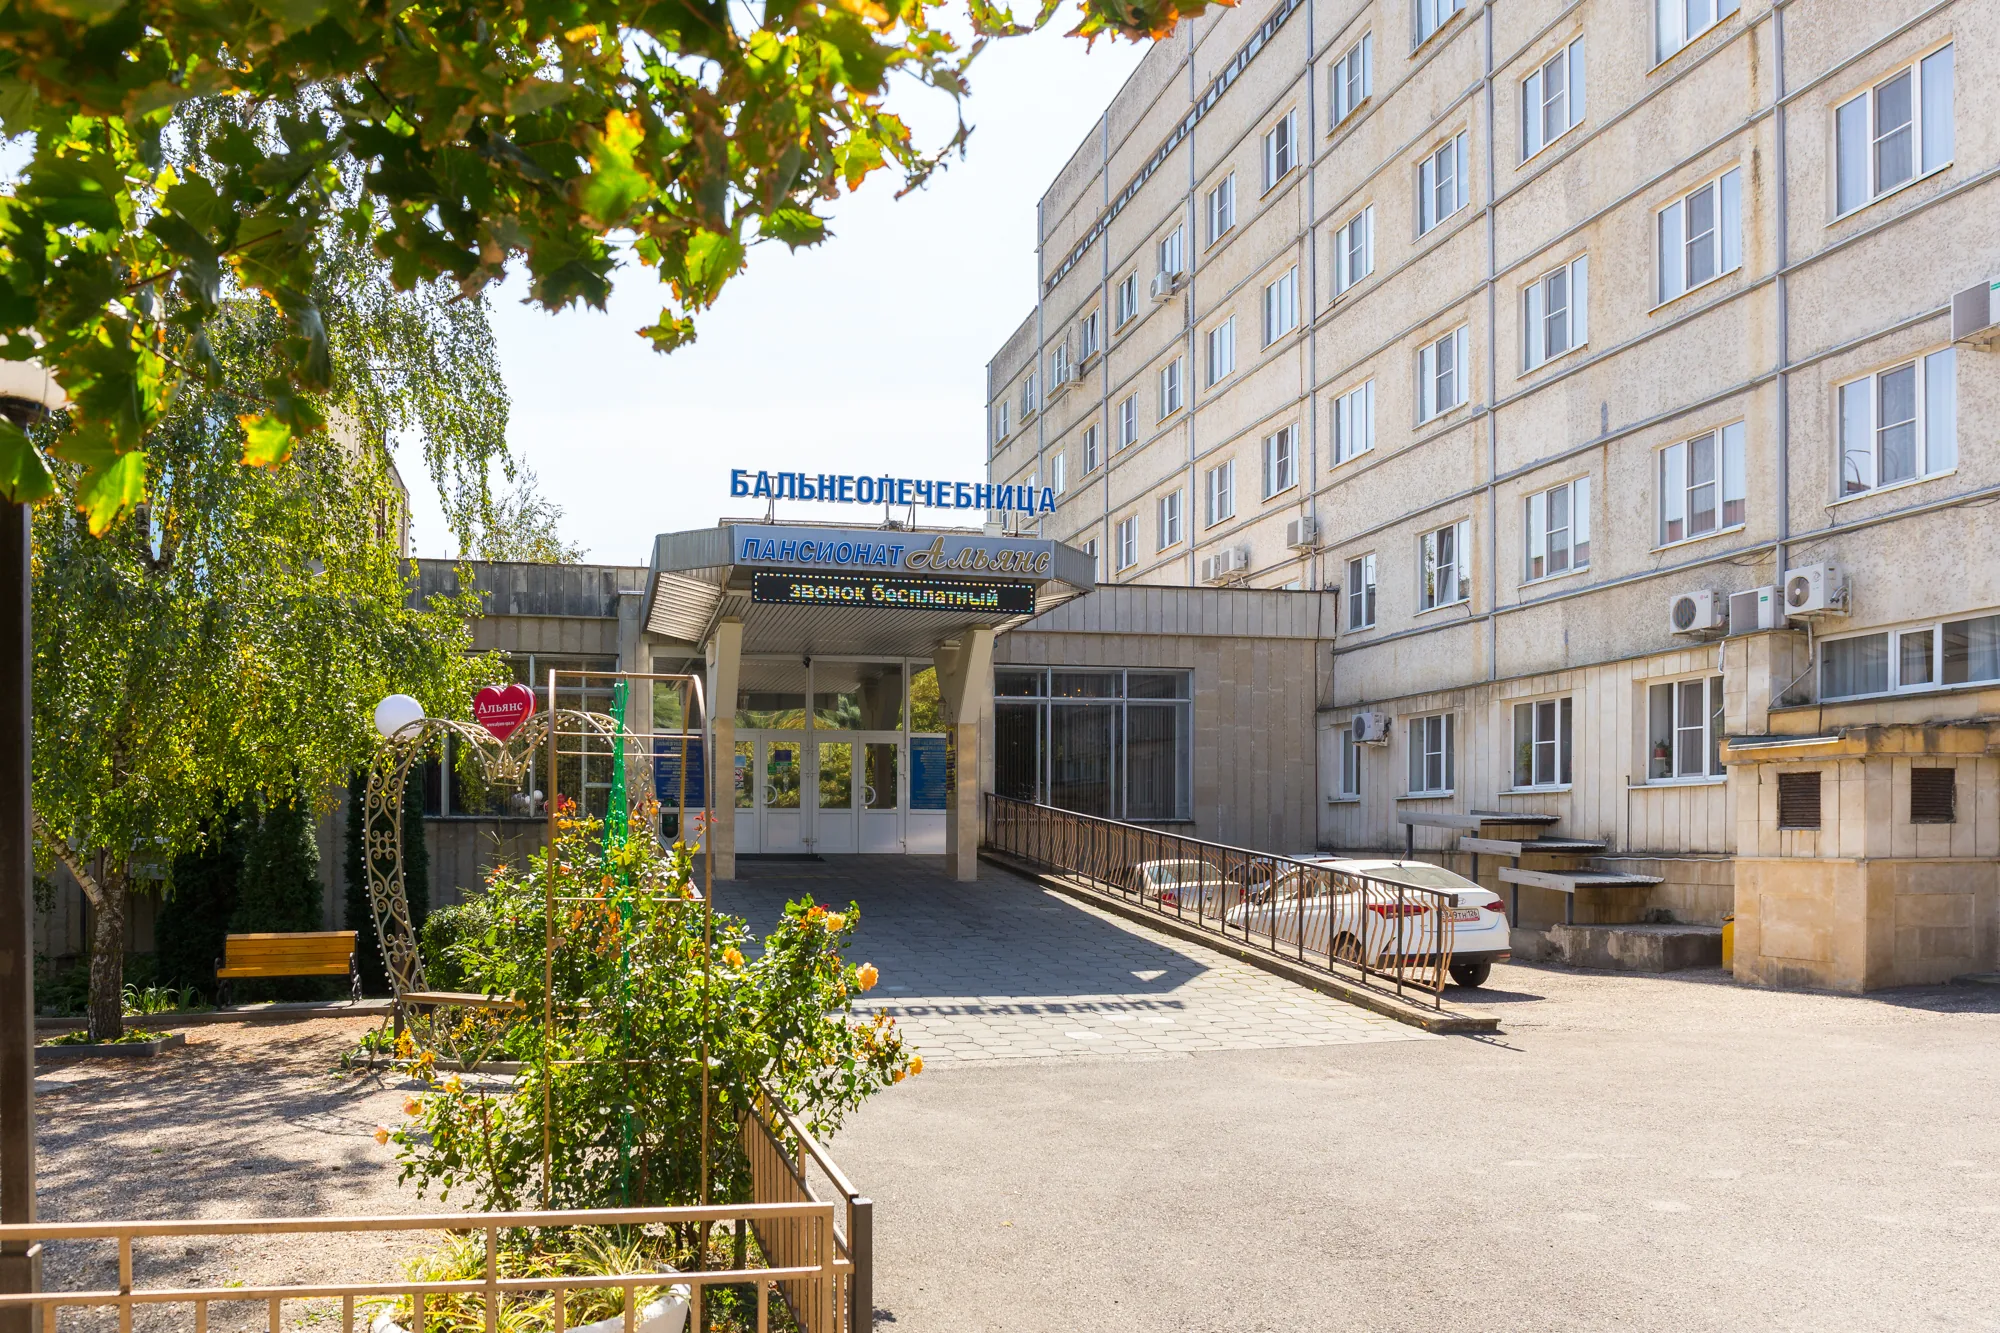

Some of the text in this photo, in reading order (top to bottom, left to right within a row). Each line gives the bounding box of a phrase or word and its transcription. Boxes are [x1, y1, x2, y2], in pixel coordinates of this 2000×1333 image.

[730, 469, 1056, 516] БАЛЬНЕОЛЕЧЕБНИЦА
[741, 535, 1051, 573] ПАНСИОНАТ Альянс
[789, 584, 999, 606] звонок бесплатный
[478, 702, 523, 714] Альянс
